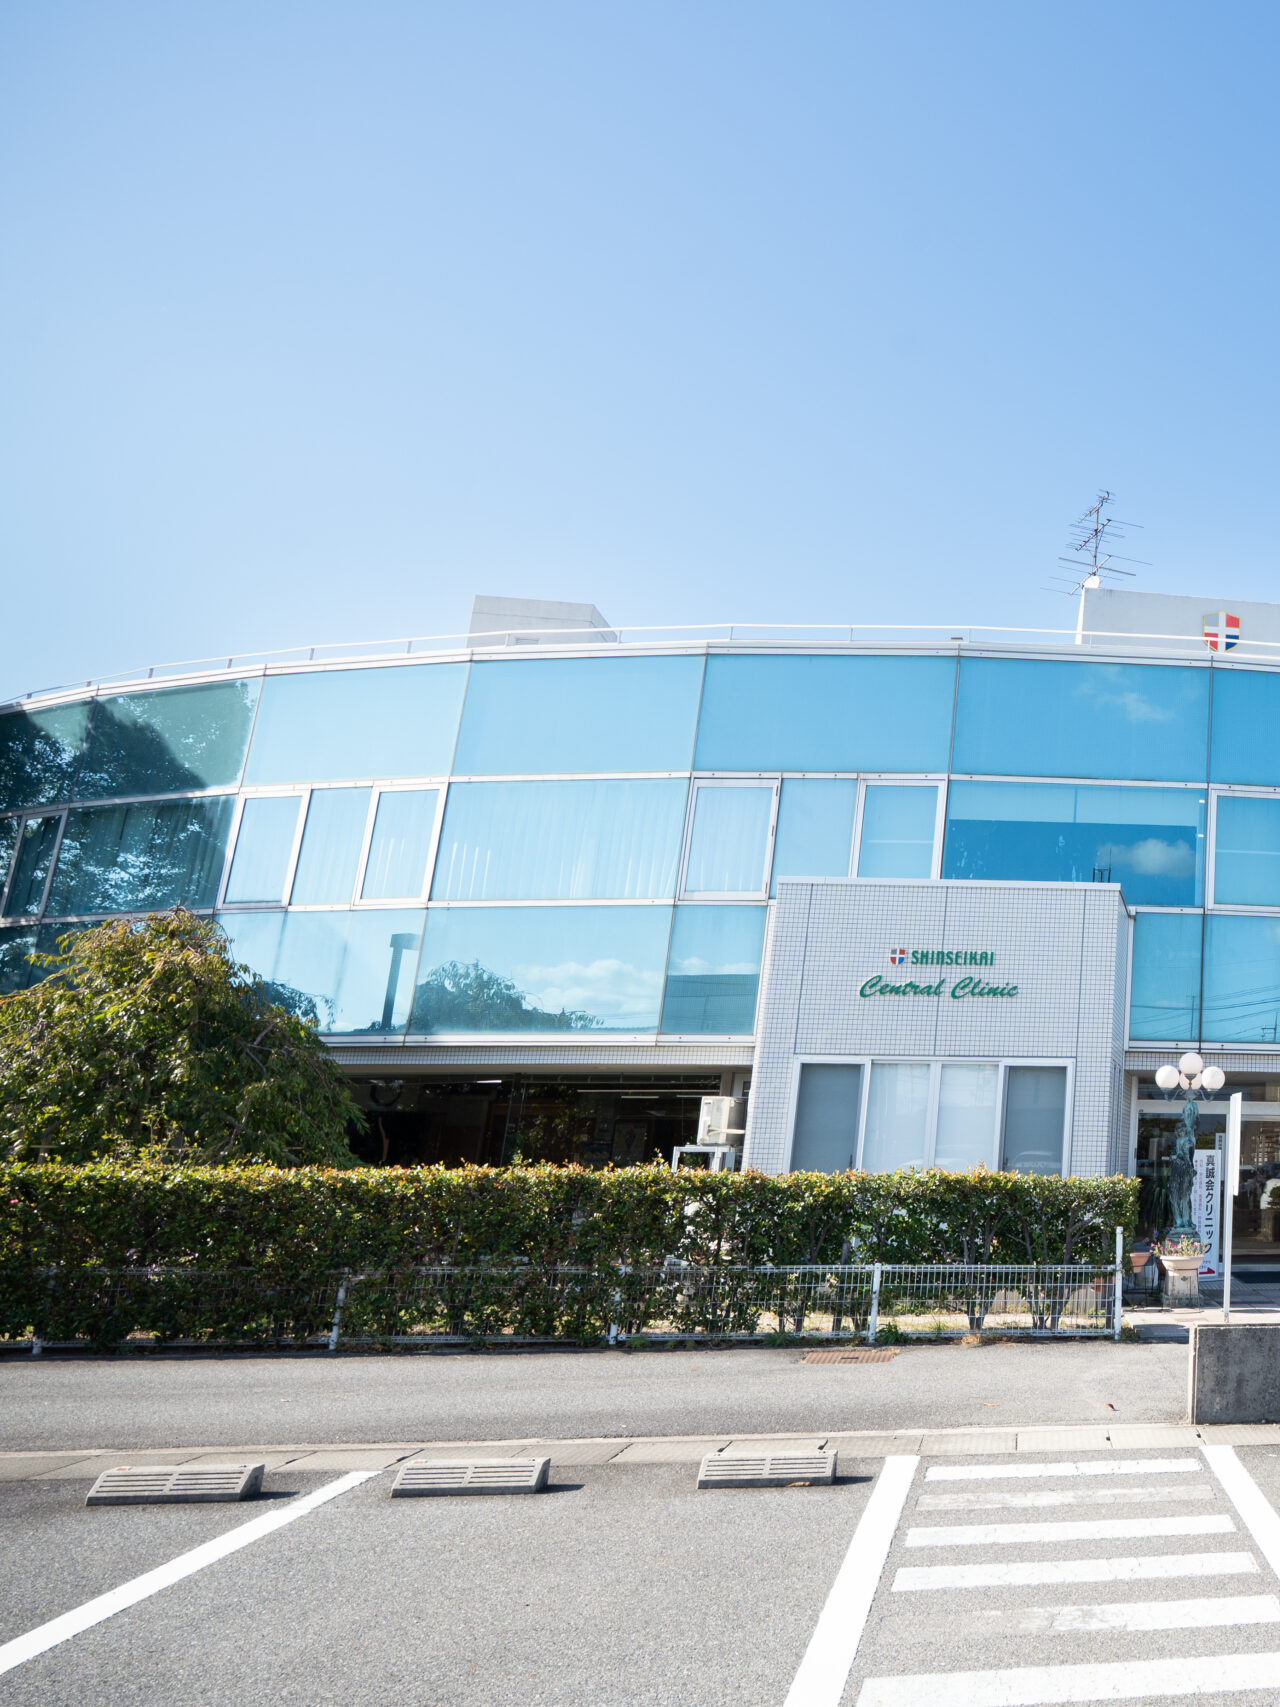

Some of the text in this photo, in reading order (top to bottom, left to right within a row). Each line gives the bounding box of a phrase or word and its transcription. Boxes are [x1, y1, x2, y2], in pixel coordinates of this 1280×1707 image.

[911, 949, 995, 967] SHINSEIKAI
[859, 974, 1019, 1000] Central Clinic
[1205, 1155, 1215, 1254] 真誠会クリニック
